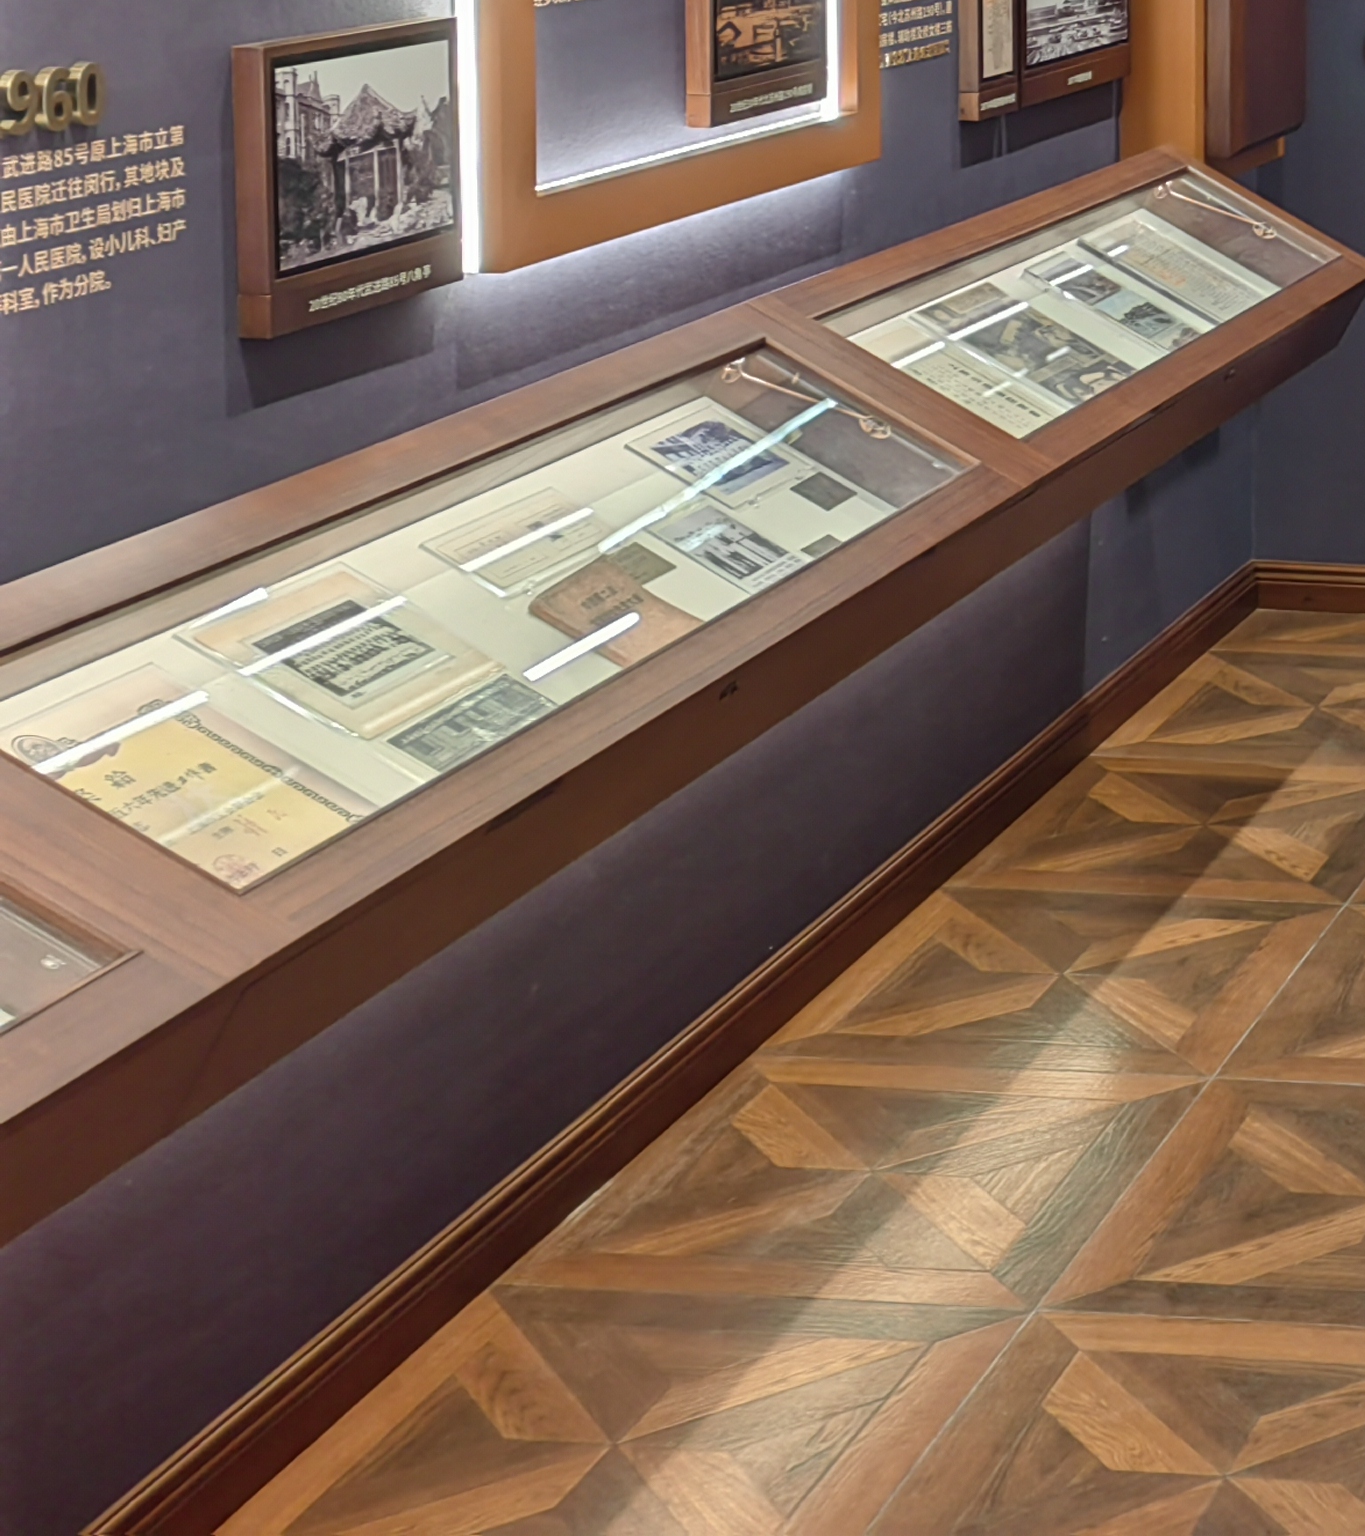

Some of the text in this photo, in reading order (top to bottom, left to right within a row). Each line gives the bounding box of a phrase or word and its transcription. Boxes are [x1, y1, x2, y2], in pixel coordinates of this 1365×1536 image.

[0, 219, 188, 282] 一人民医院，设小儿科、妇产
[0, 269, 112, 316] 科室，作为分院。
